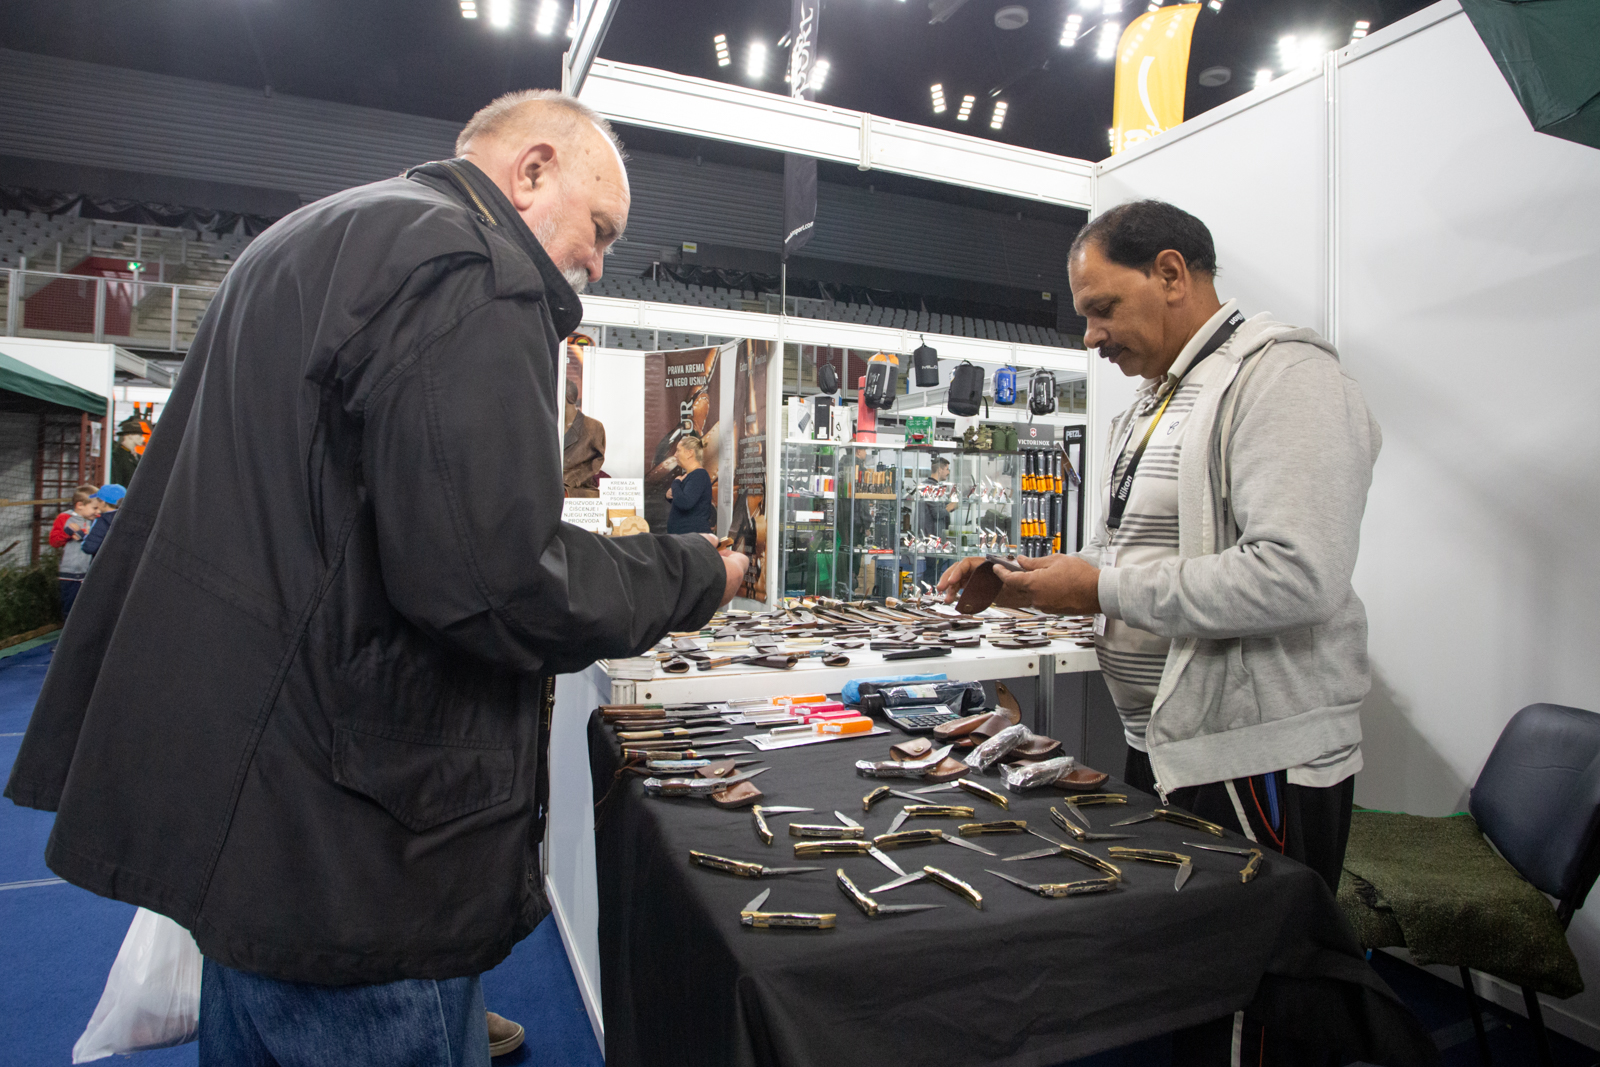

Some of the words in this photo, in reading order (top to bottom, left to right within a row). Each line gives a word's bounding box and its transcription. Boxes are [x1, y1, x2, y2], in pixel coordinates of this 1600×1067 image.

[667, 365, 685, 375] PRAVA
[685, 363, 705, 374] KREMA
[665, 378, 674, 388] ZA
[673, 377, 688, 387] NEGO
[680, 400, 694, 439] UR
[1017, 438, 1050, 446] VICTORINOX
[1117, 475, 1133, 501] Nikon
